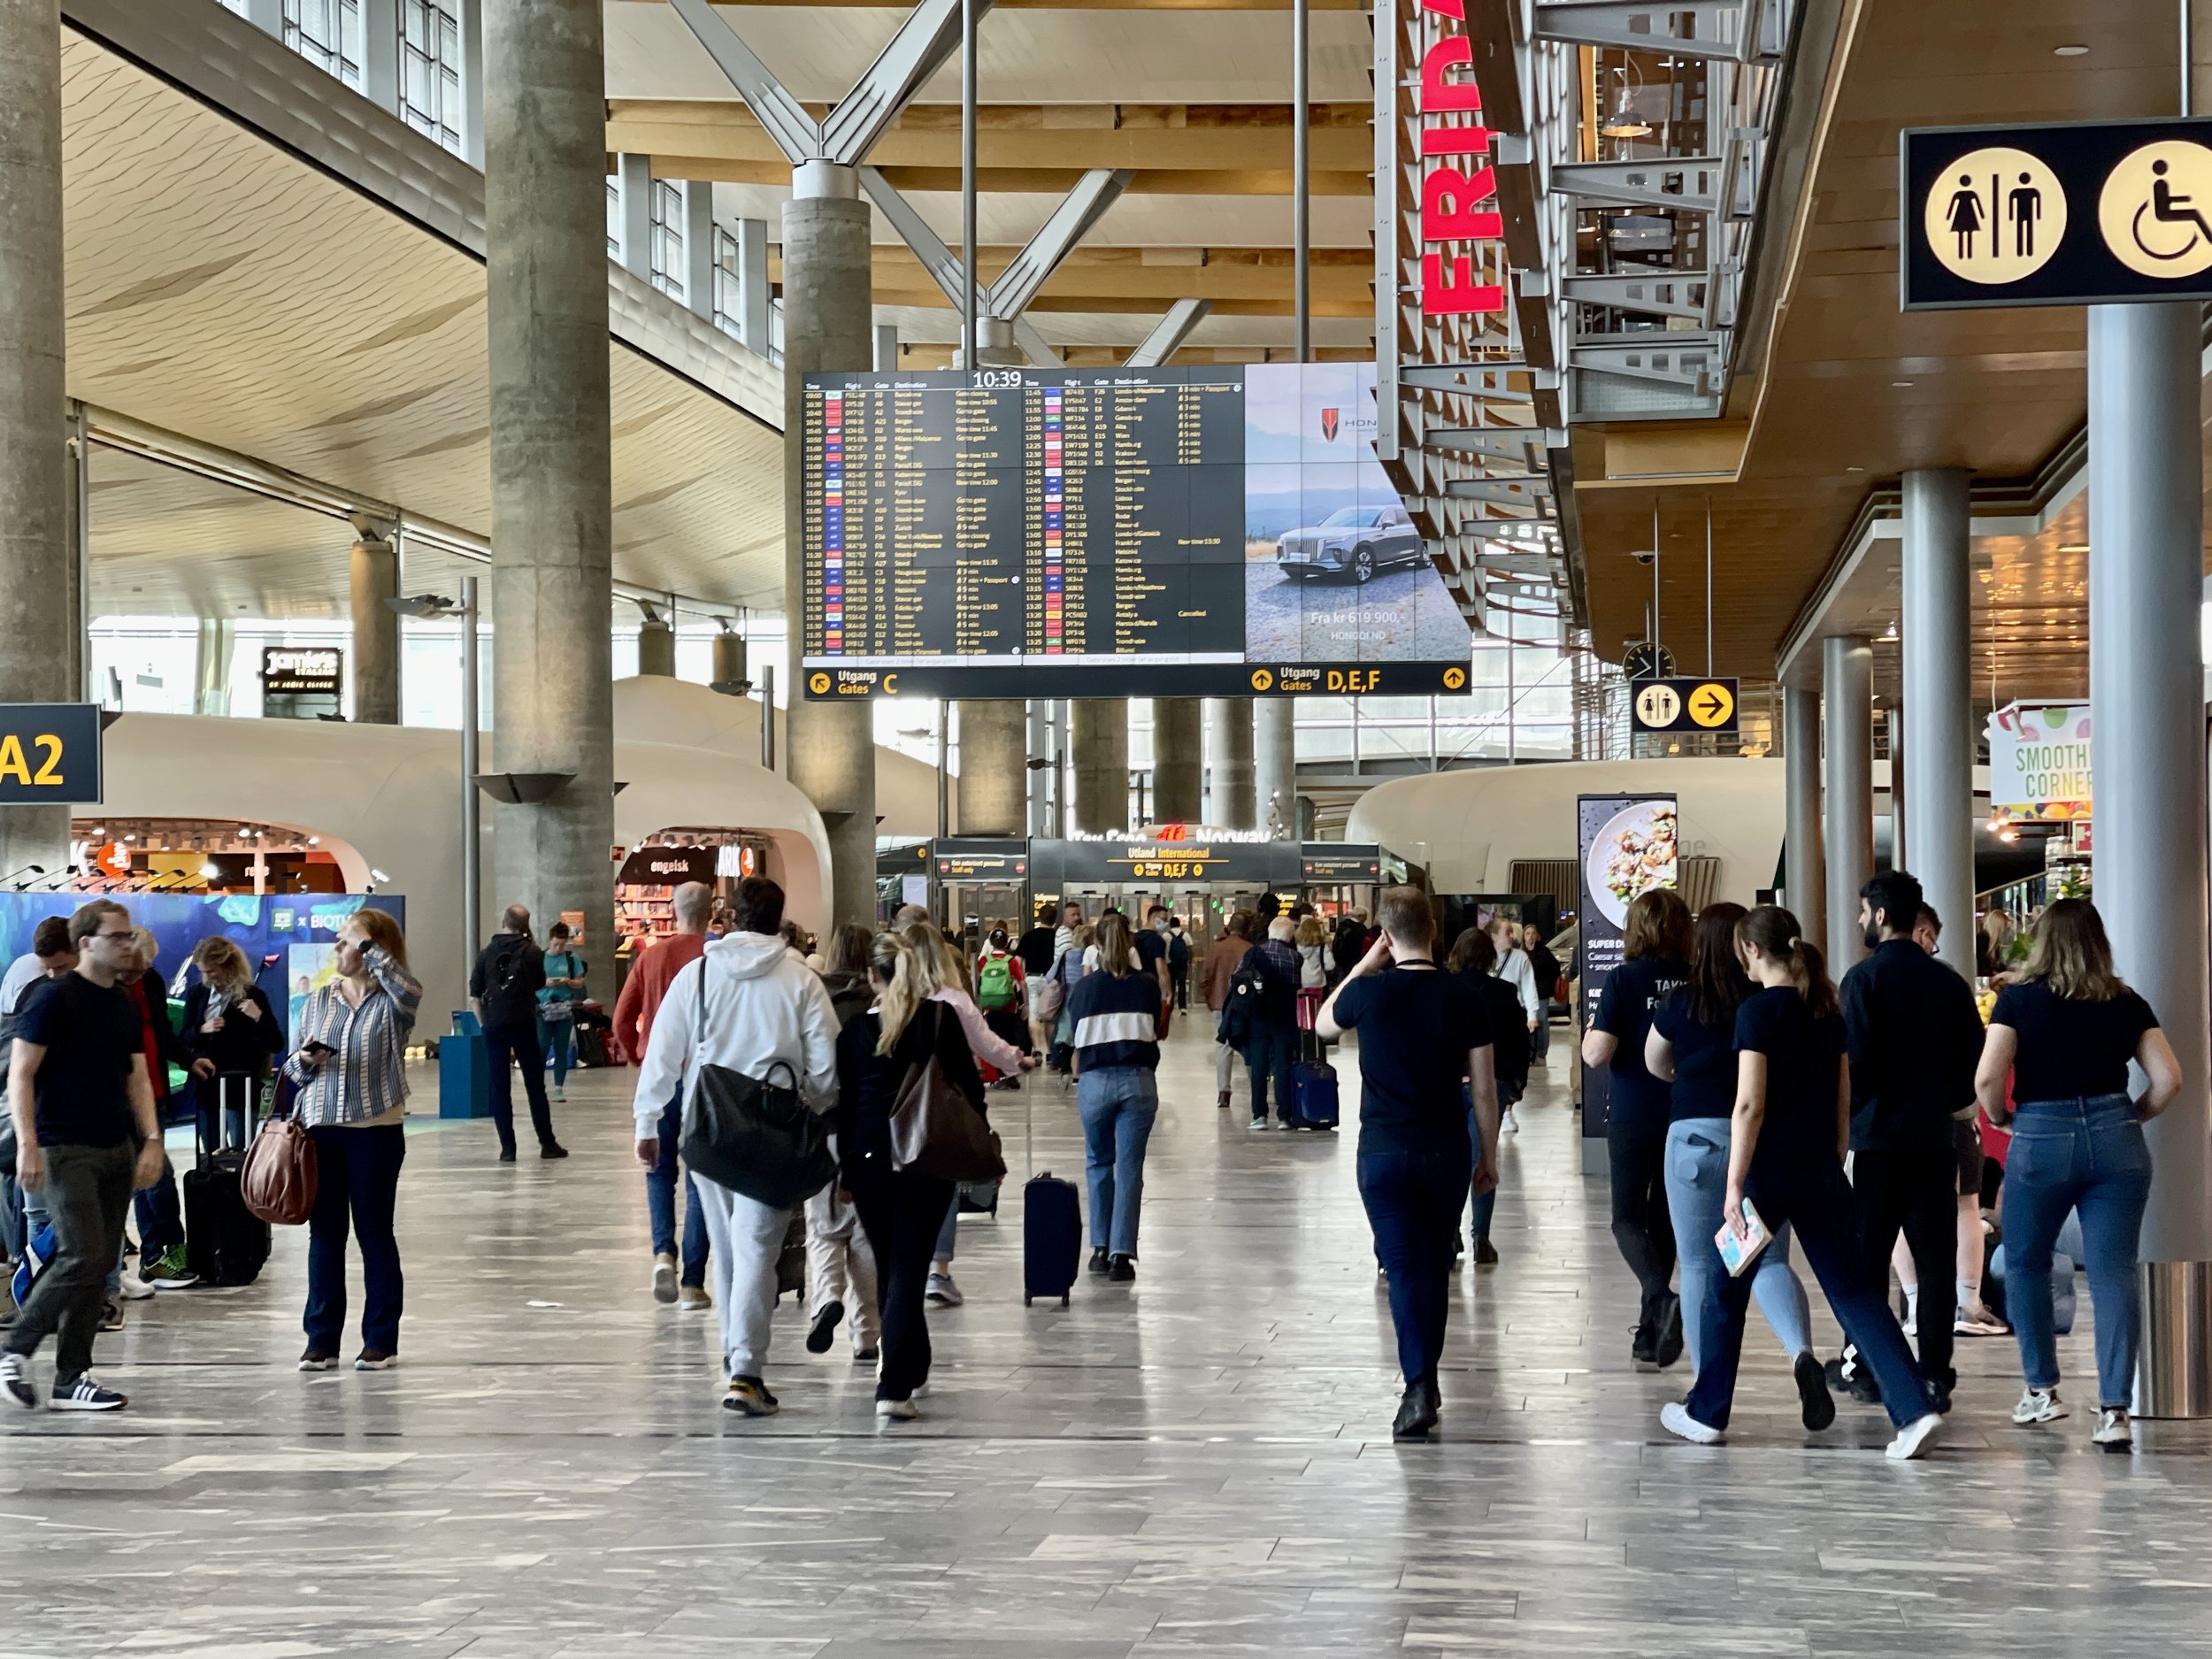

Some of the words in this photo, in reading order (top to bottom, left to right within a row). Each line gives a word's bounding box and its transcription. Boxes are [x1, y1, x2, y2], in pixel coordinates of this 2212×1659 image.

[973, 371, 1021, 388] 10:39
[1310, 612, 1330, 624] Fra
[1333, 611, 1345, 623] kr
[838, 670, 877, 684] Utgang
[883, 674, 897, 695] C
[1280, 667, 1320, 680] Utgang
[1327, 670, 1381, 694] D,E,F
[1280, 680, 1312, 691] Gates
[838, 684, 869, 695] Gates
[0, 734, 64, 786] A2
[1127, 847, 1156, 858] Utland
[1157, 847, 1210, 859] International
[650, 859, 688, 874] engelsk
[718, 846, 741, 877] ARK
[1164, 864, 1187, 878] D,E,F
[1587, 940, 1615, 949] SUPER
